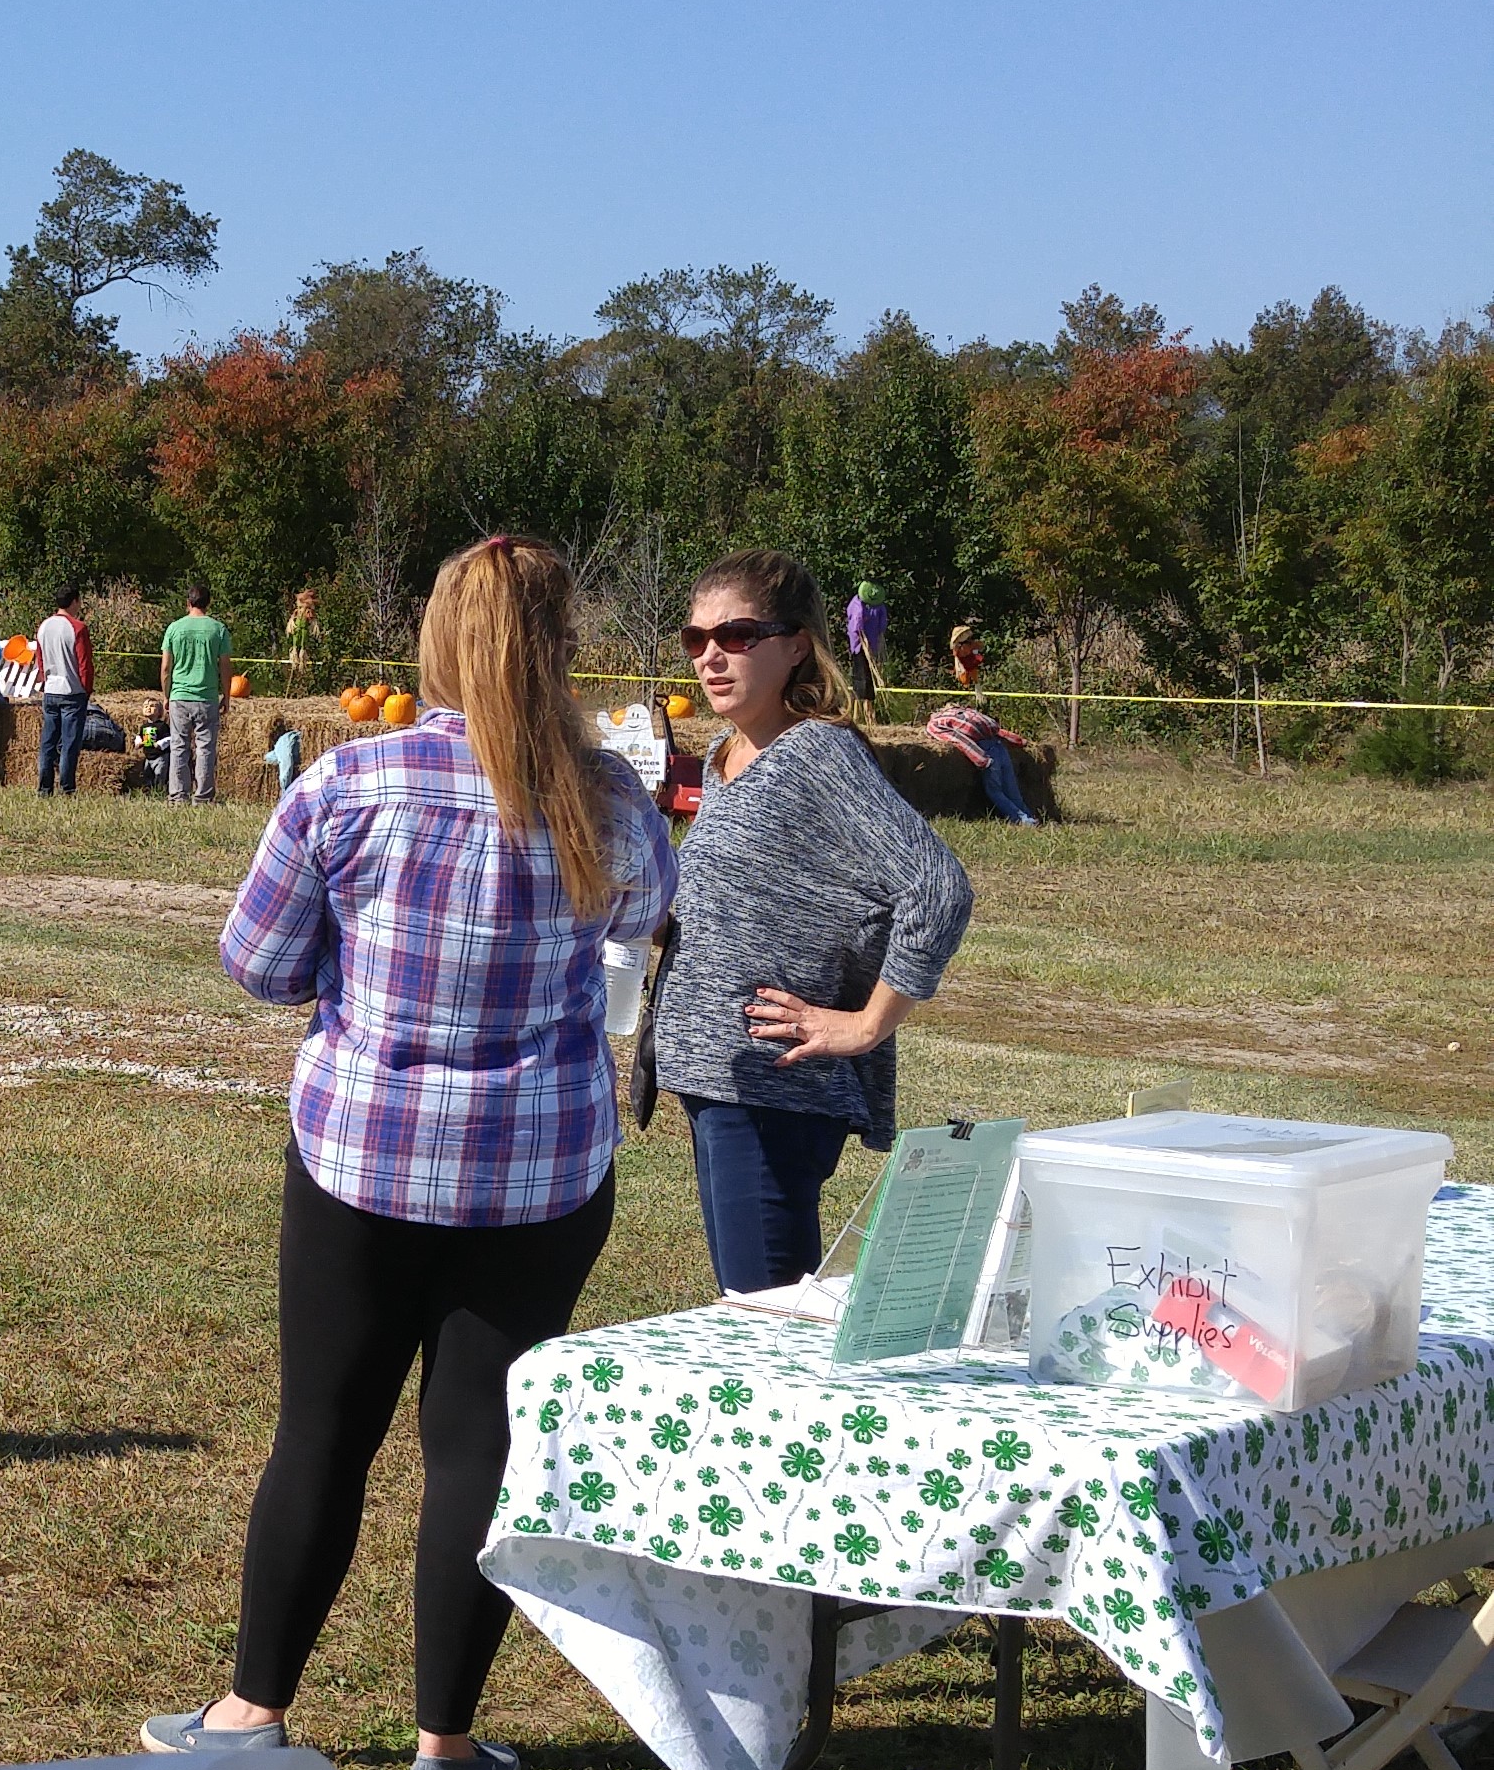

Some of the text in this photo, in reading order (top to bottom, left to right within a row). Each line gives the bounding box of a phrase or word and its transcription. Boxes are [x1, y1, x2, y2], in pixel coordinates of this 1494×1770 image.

[632, 759, 660, 767] Tykes
[1106, 1246, 1237, 1308] Exhibit
[1108, 1302, 1235, 1355] Supplies
